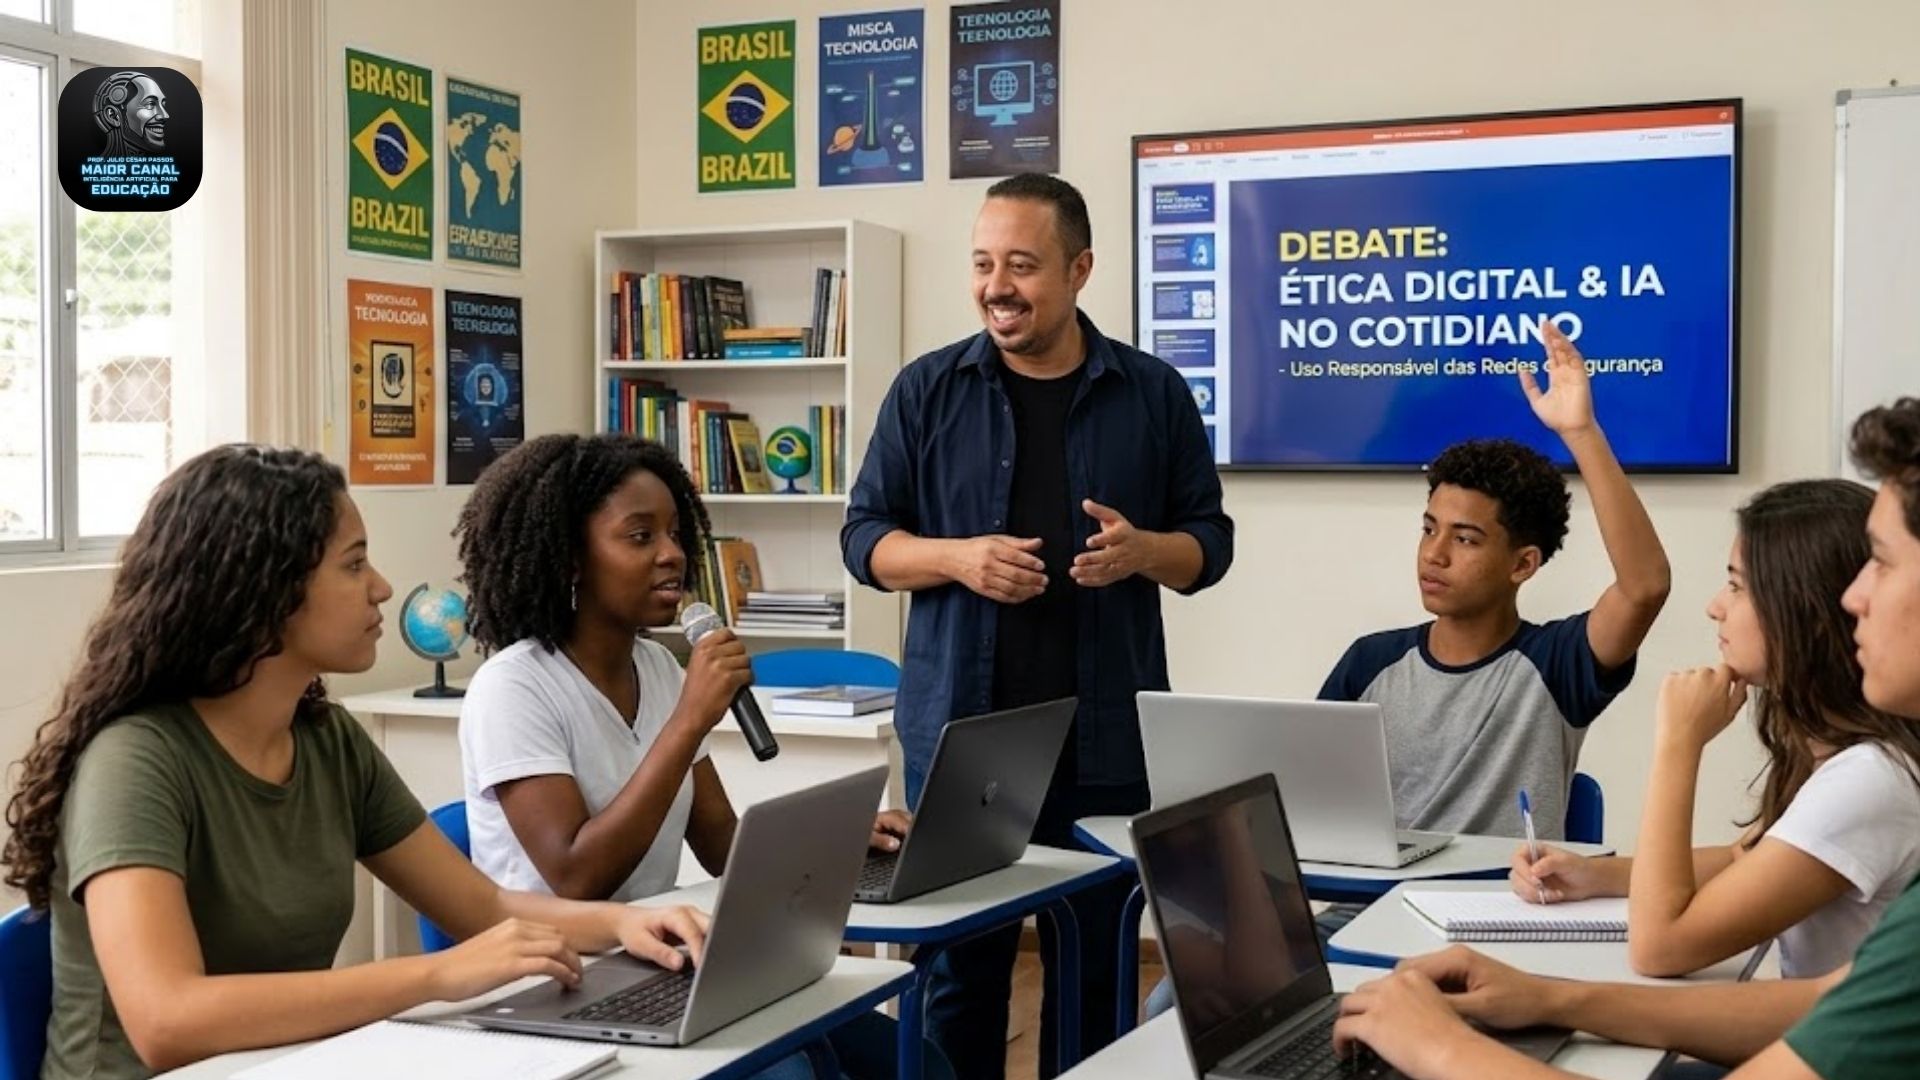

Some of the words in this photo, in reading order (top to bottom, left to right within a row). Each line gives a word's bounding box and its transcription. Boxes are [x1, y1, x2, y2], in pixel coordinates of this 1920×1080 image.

[824, 36, 918, 56] TECNOLOGIA
[847, 21, 894, 37] MISCA
[702, 30, 792, 65] BRASIL
[350, 58, 429, 107] BRASIL
[702, 151, 792, 184] BRAZIL
[351, 196, 430, 238] BRAZIL
[1280, 226, 1448, 262] DEBATE:
[1280, 267, 1394, 305] ÉTICA
[1405, 267, 1567, 303] DIGITAL
[1578, 265, 1607, 298] &
[1621, 264, 1665, 296] IA
[1280, 317, 1338, 349] NO
[1350, 311, 1583, 349] COTIDIANO
[1290, 361, 1324, 377] Uso
[1328, 357, 1438, 380] Responsável
[1443, 357, 1477, 376] das
[1481, 357, 1539, 375] Redes
[1583, 358, 1664, 377] gurança
